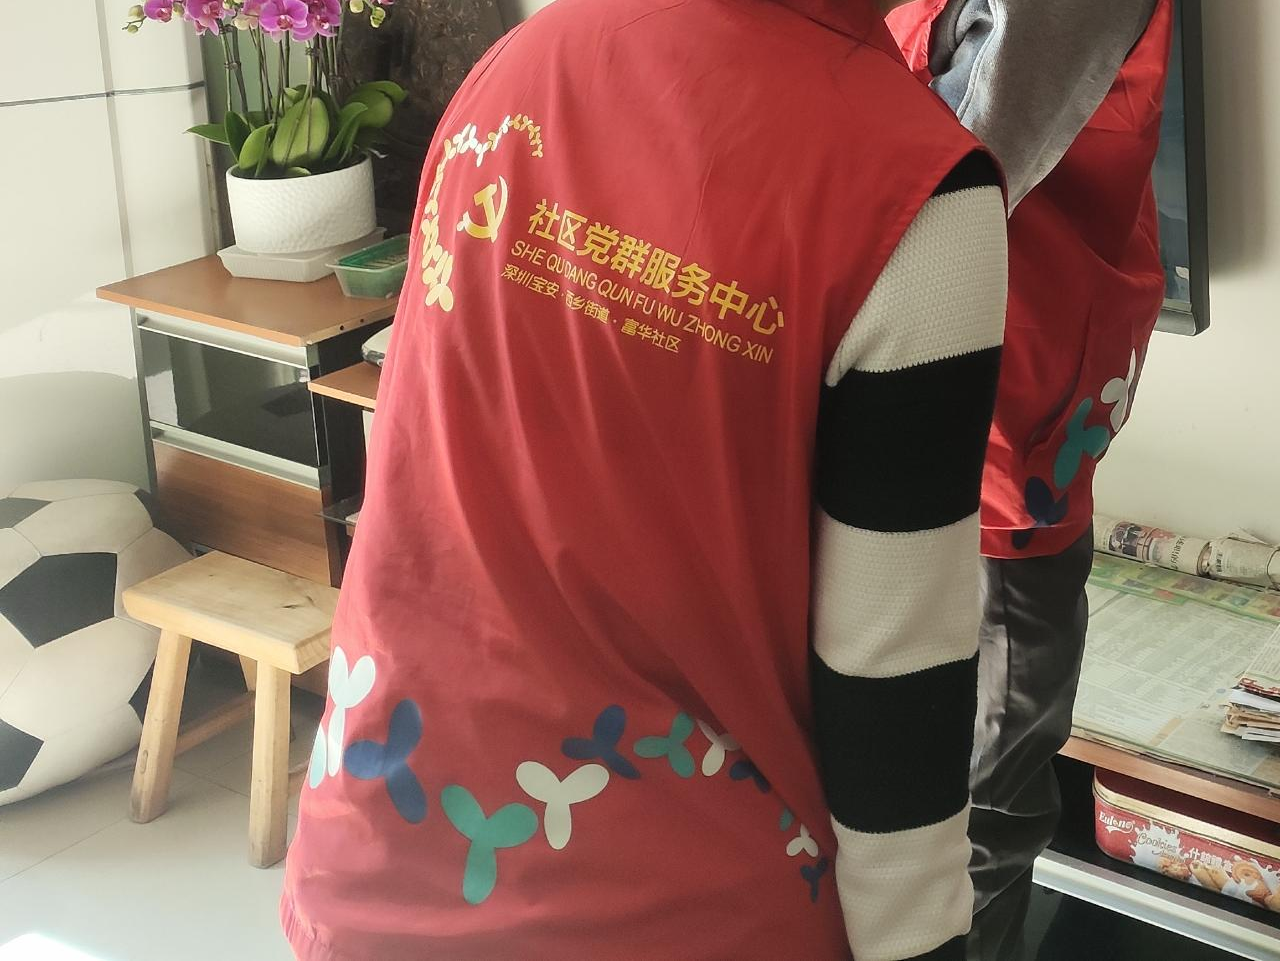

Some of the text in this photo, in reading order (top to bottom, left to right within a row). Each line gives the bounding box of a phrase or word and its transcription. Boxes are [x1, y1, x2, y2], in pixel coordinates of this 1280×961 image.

[511, 240, 546, 266] SHE
[597, 279, 634, 307] QUN
[632, 292, 656, 315] FU
[657, 302, 684, 327] WU
[683, 314, 742, 353] ZHONG
[741, 340, 774, 364] XIN
[528, 199, 784, 335] 社区党群服务中心
